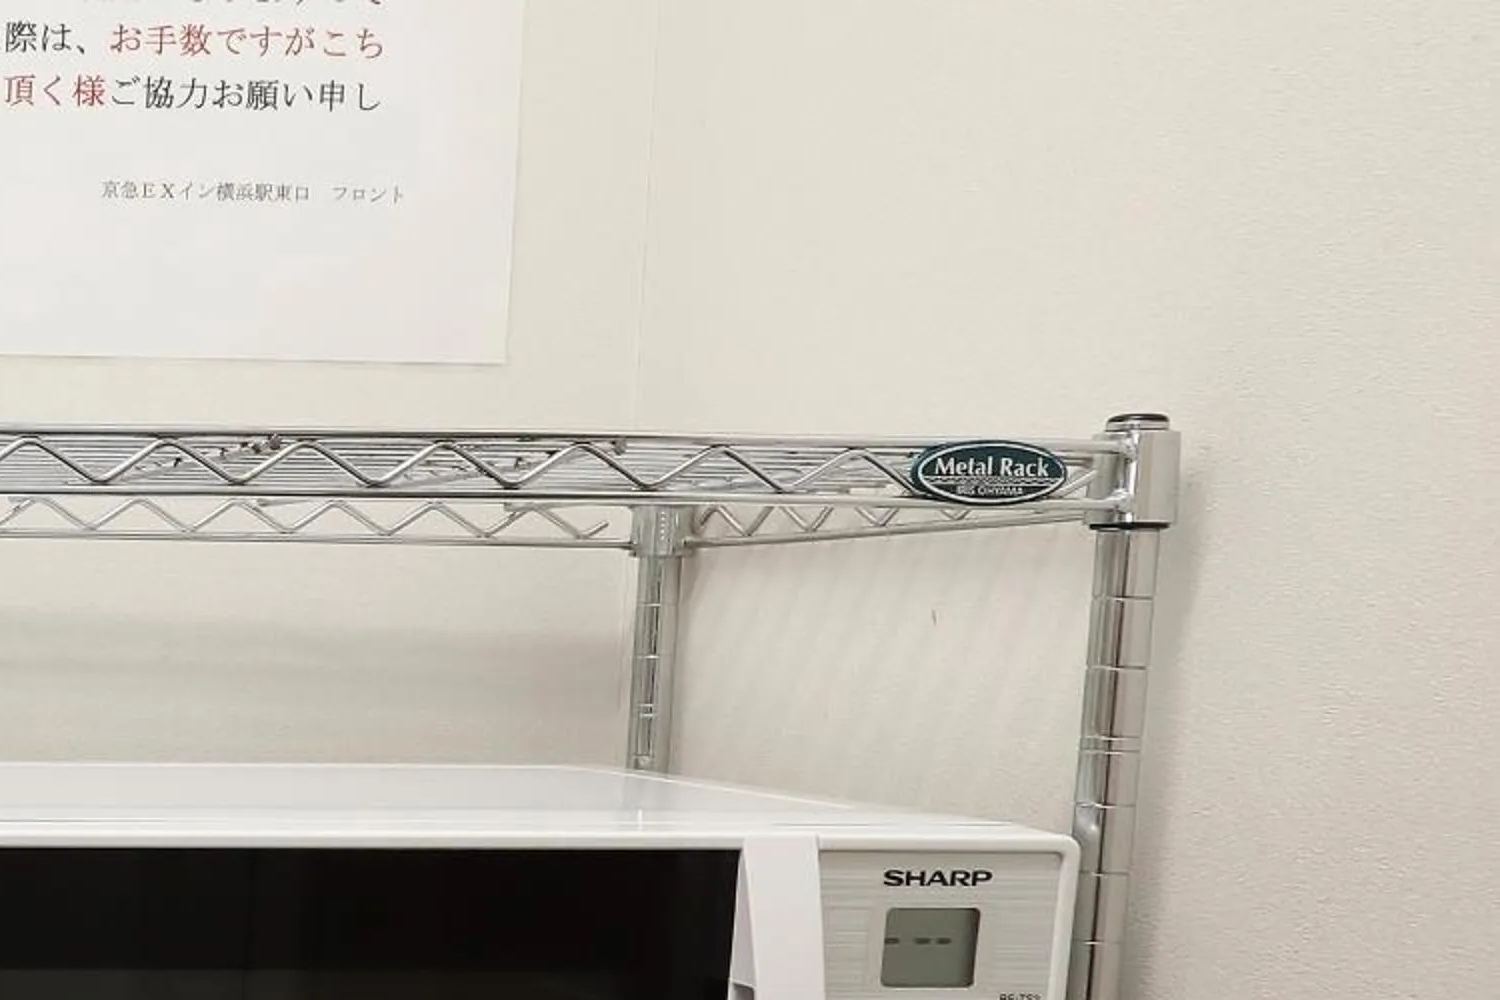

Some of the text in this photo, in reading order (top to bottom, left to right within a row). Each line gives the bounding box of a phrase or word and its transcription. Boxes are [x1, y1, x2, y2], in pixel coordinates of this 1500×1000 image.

[935, 456, 1049, 477] Metal Rack
[883, 869, 993, 886] SHARP
